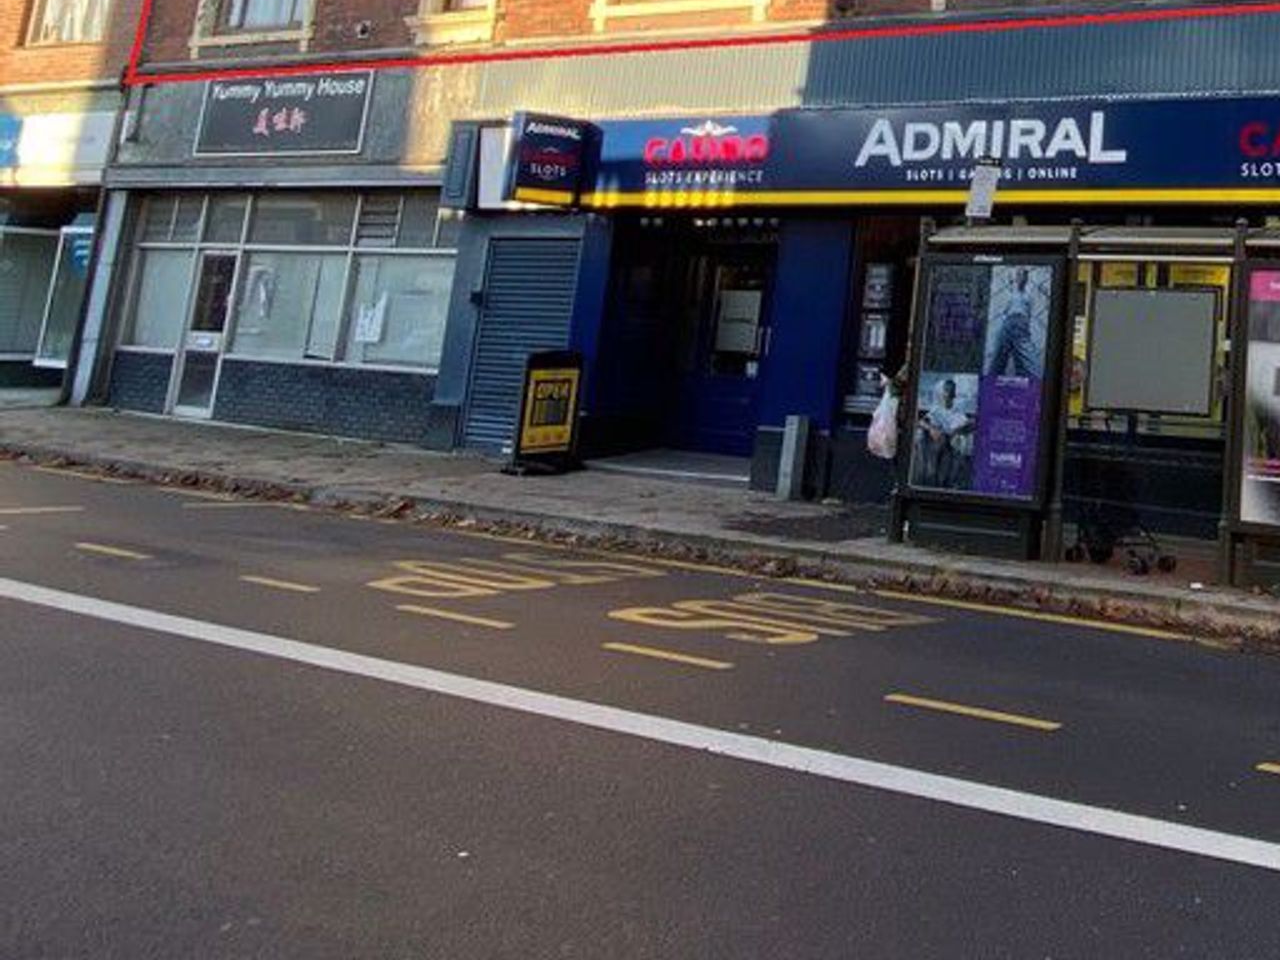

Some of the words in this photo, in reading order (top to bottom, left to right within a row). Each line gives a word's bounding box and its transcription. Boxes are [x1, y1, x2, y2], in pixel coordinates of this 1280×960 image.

[212, 83, 262, 103] Yummy
[264, 80, 316, 101] Yummy
[317, 77, 366, 96] House
[854, 111, 1127, 167] ADMIRAL
[644, 171, 682, 185] SLOTS
[684, 169, 765, 185] EXPERIENCE
[906, 168, 945, 182] SLOTS
[1027, 166, 1078, 180] ONLINE
